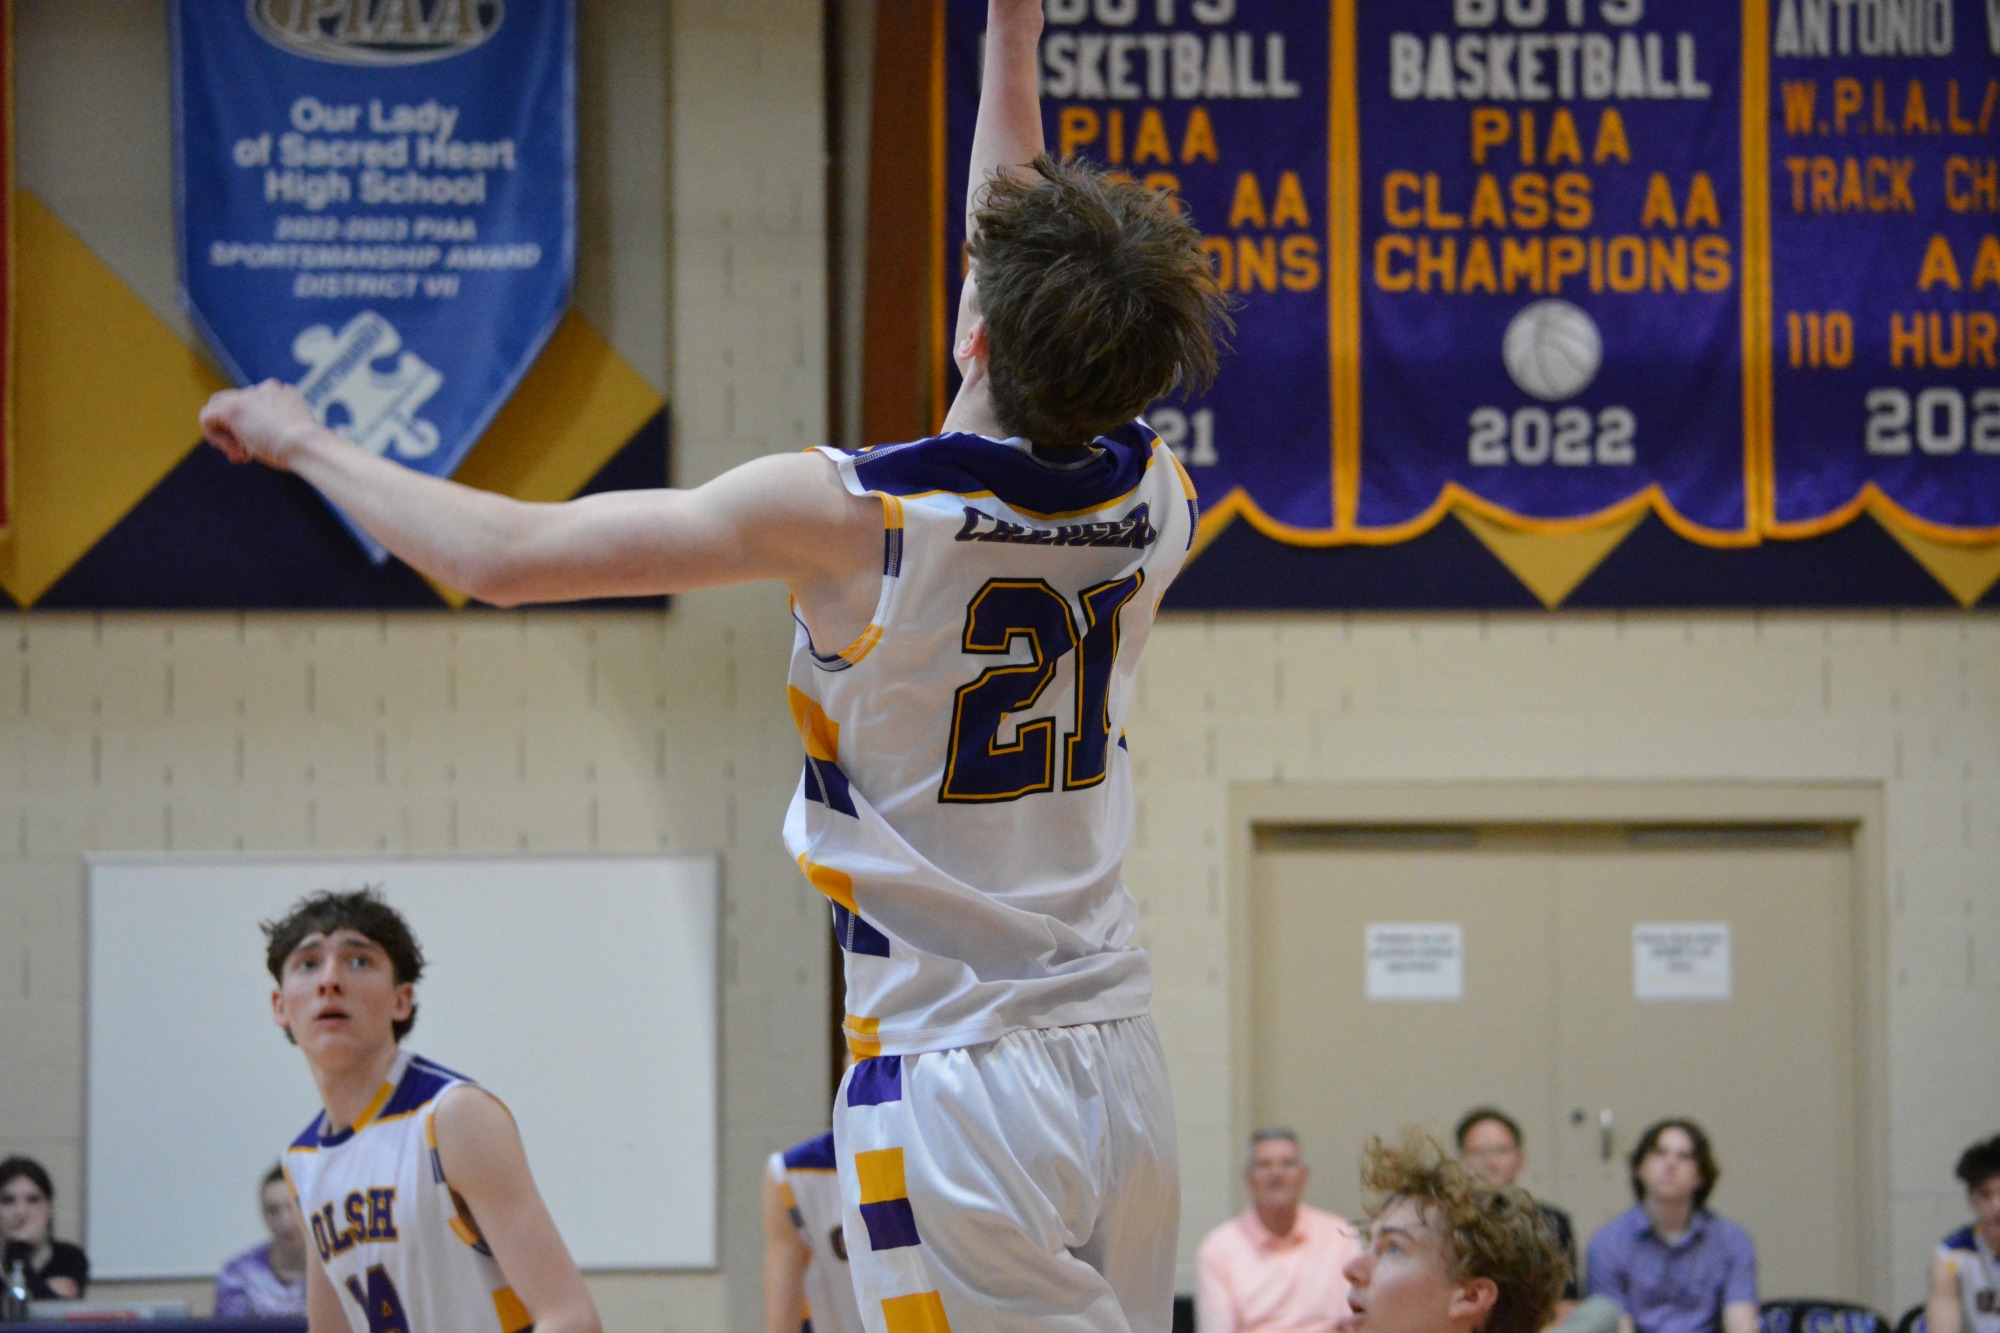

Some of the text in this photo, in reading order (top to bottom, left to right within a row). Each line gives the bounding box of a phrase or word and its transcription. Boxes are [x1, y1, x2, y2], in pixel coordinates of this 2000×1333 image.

[1775, 0, 1953, 57] ANTONIO
[979, 33, 1300, 99] SKETBALL
[1390, 32, 1711, 99] BASKETBALL
[291, 97, 459, 141] Our Lady
[1060, 106, 1219, 164] PIAA
[1471, 107, 1630, 165] PIAA
[233, 132, 516, 170] of Sacred Heart
[265, 171, 486, 210] High School
[1230, 171, 1310, 229] AA
[1383, 172, 1721, 231] CLASS AA
[1785, 155, 1916, 214] TRACK
[210, 241, 542, 270] SPORTSMANSHIP AWARD
[1374, 236, 1732, 294] CHAMPIONS
[293, 273, 419, 298] DISTRICT
[1787, 310, 1854, 369] 110
[1150, 408, 1218, 466] 21
[1468, 407, 1636, 467] 2022
[938, 567, 1145, 803] 21
[311, 1186, 399, 1264] OLSH
